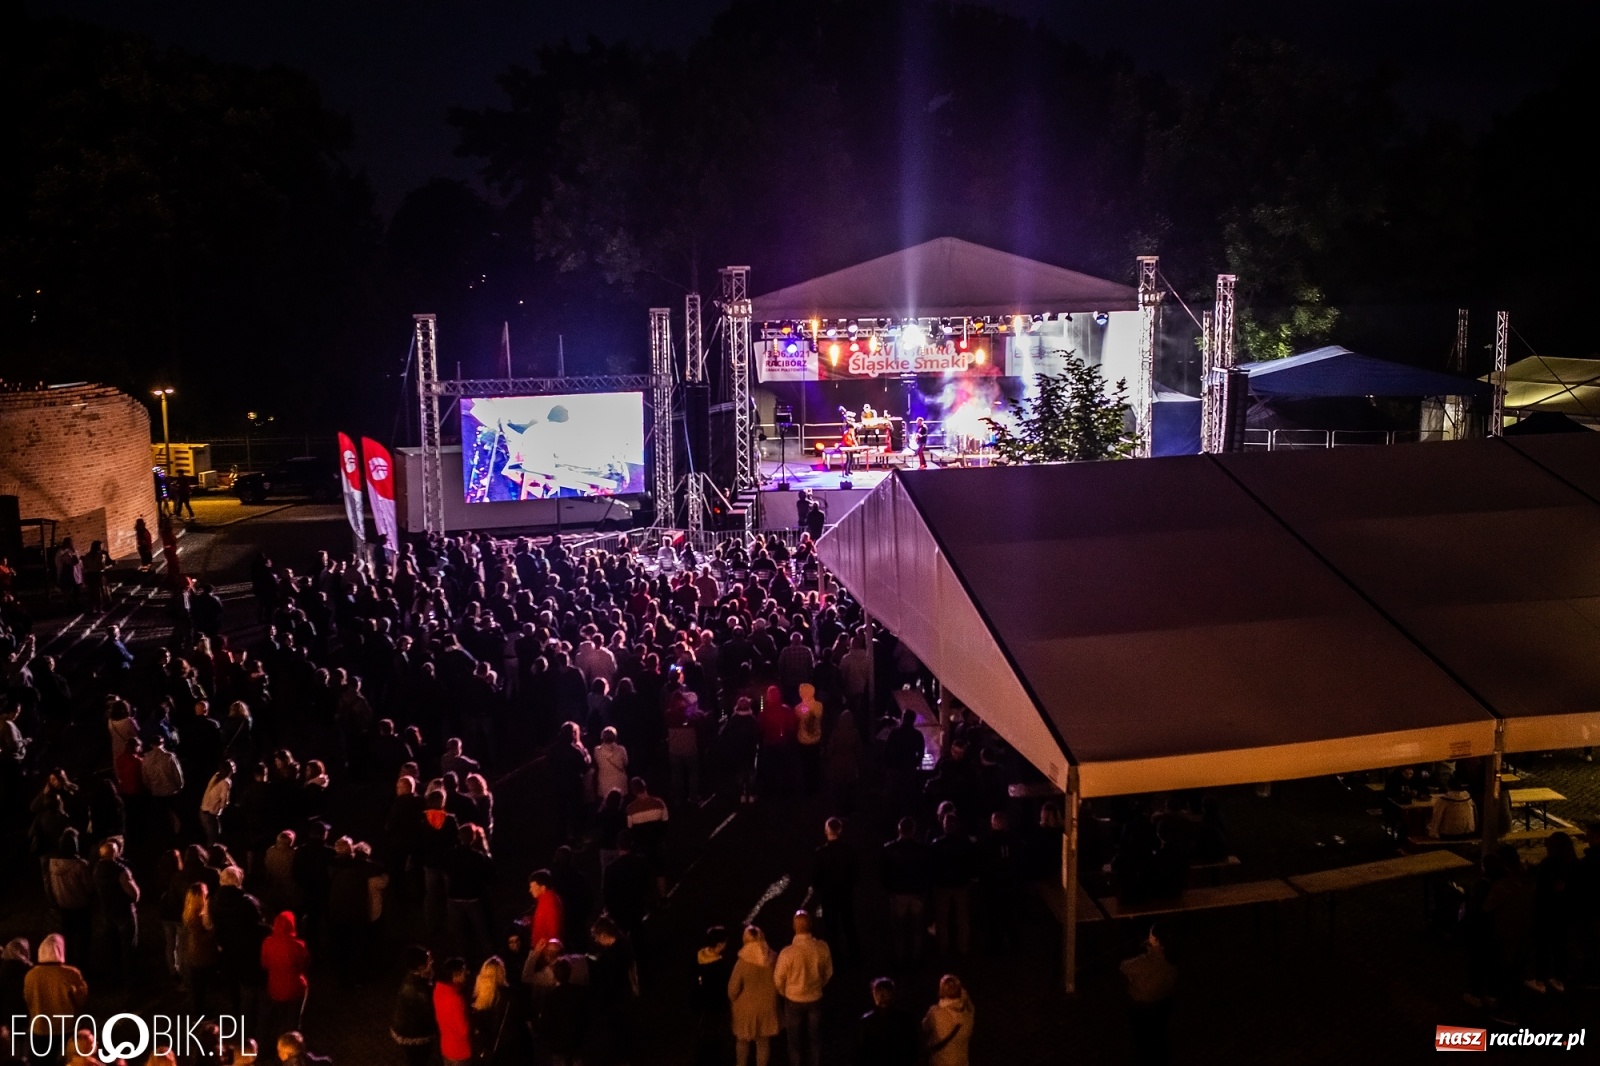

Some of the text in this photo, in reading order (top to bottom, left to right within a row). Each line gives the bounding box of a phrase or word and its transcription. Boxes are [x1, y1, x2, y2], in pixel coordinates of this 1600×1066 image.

[765, 359, 807, 367] RACIBÓRZ
[852, 354, 967, 374] Śląskie Smaki
